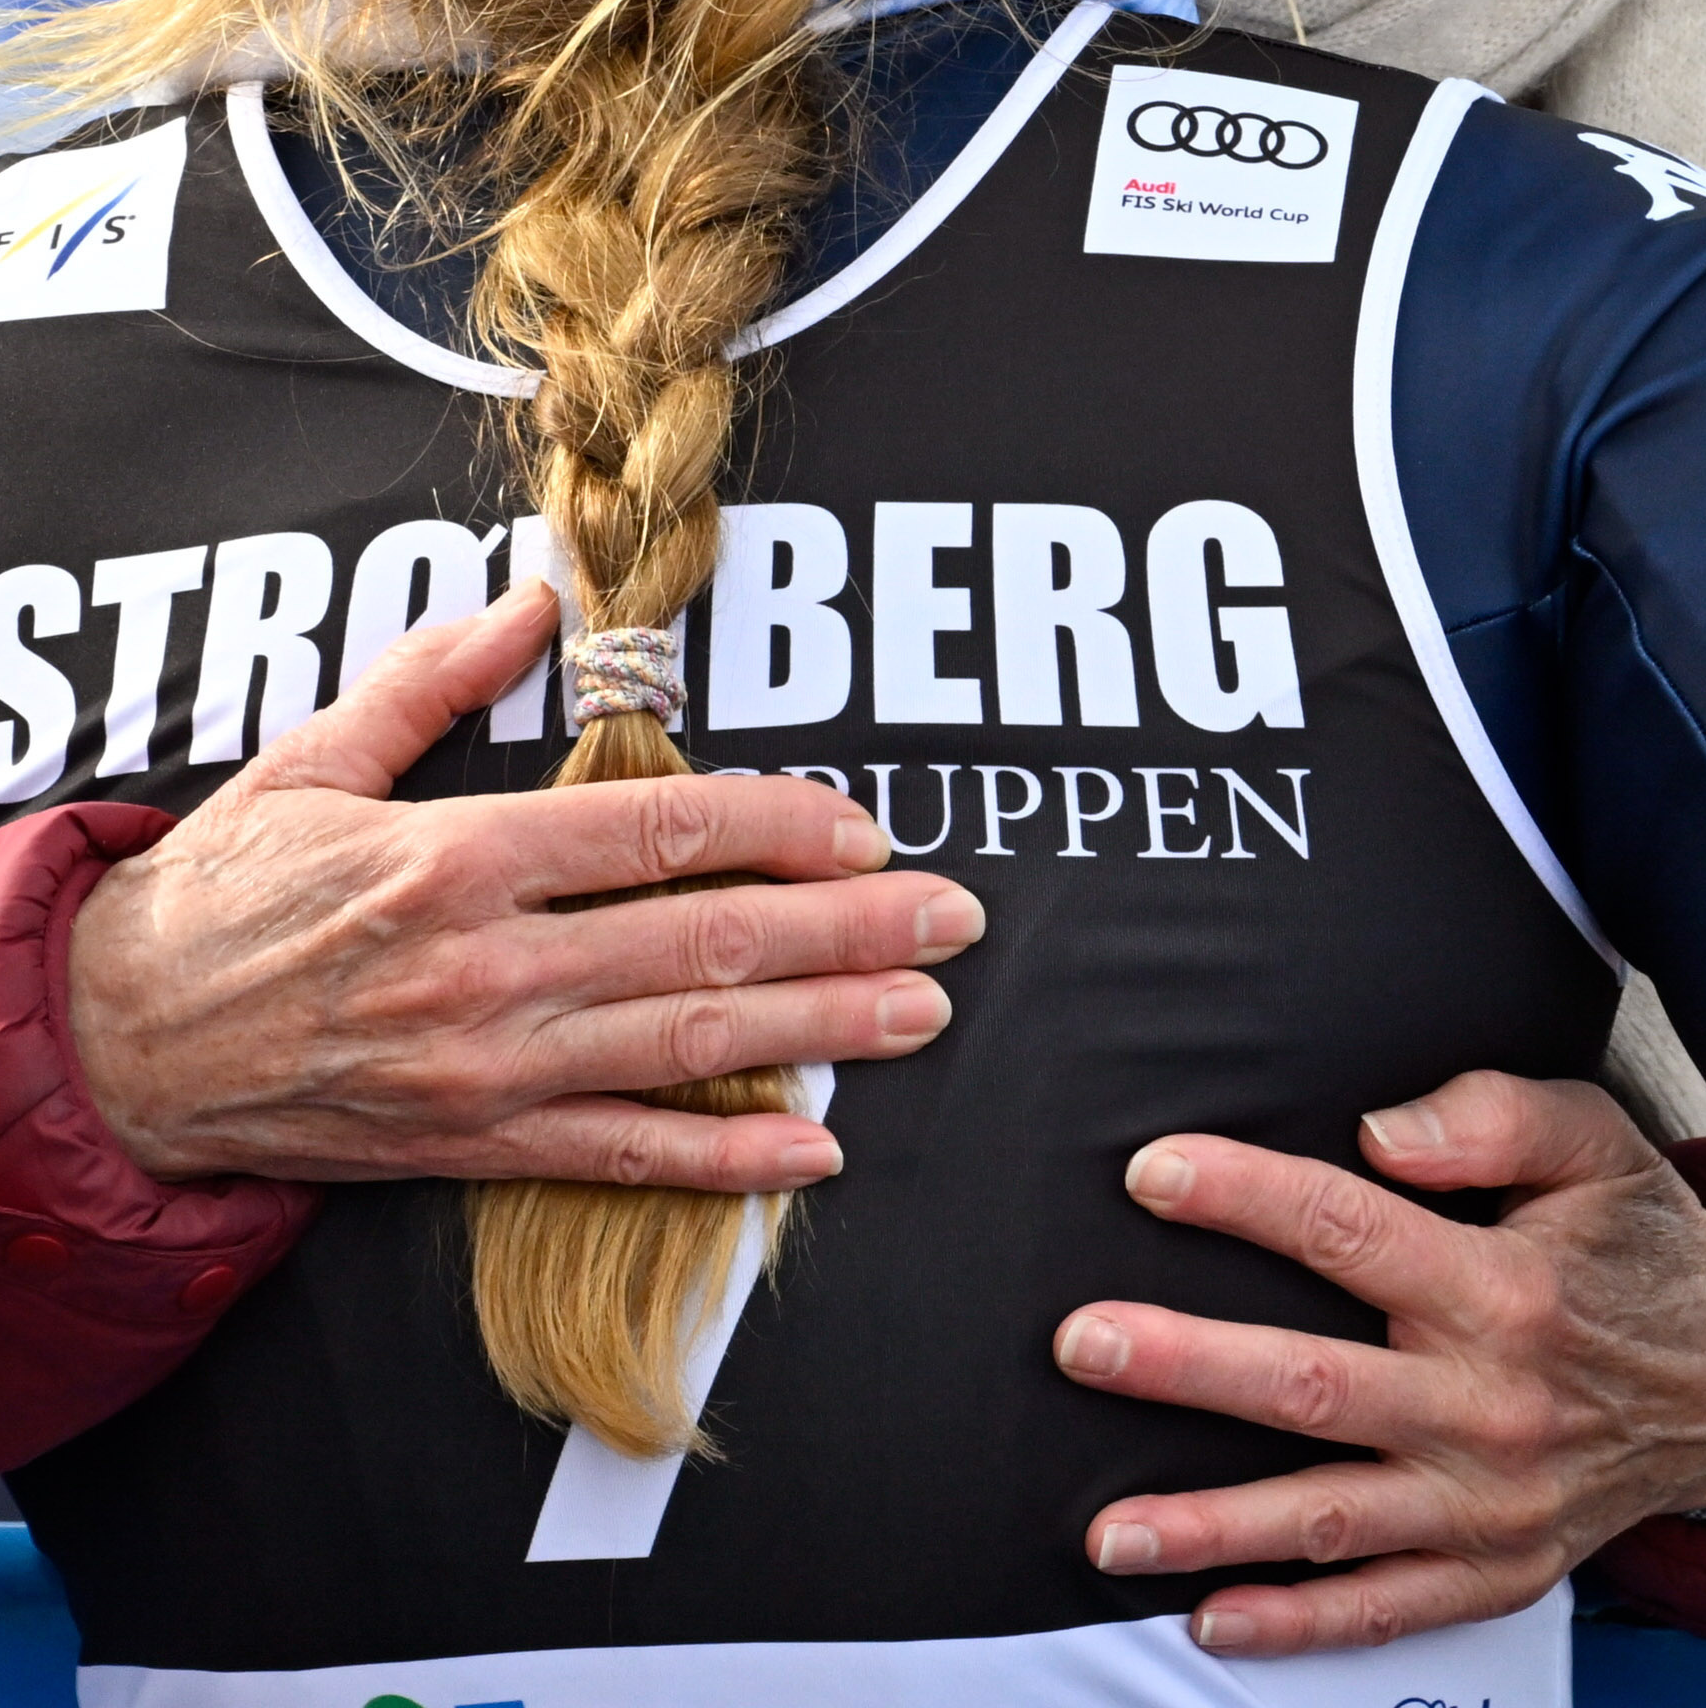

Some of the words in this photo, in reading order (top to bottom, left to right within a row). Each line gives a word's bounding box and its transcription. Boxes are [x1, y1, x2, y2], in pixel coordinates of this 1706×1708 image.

[1123, 178, 1177, 195] Audi
[1121, 194, 1156, 210] FIS
[1162, 197, 1193, 213] Ski
[1199, 201, 1263, 219] World
[1269, 208, 1310, 225] Cup
[705, 763, 1311, 862] UPPEN
